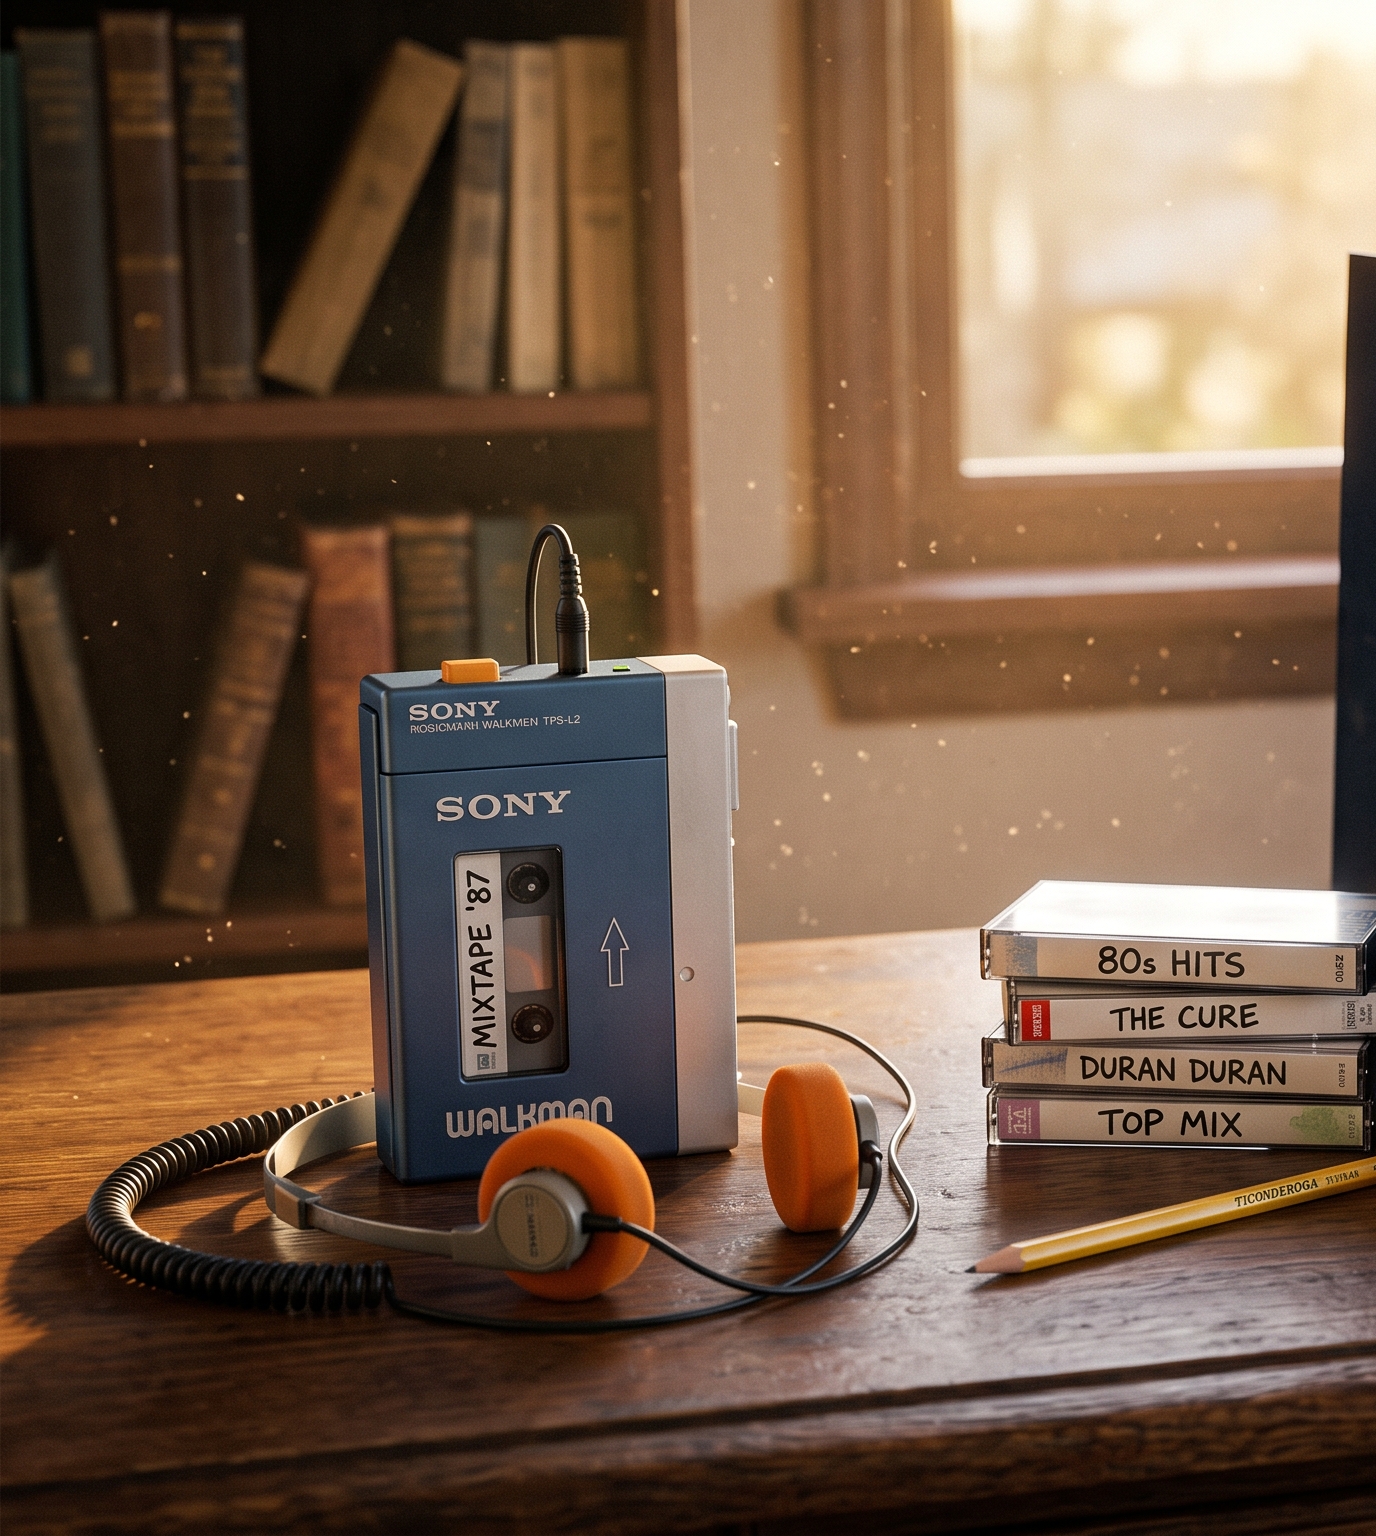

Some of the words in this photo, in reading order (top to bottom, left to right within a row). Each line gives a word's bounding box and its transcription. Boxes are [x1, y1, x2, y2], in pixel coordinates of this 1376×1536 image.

[409, 700, 500, 721] SONY
[482, 717, 538, 729] WALKMEN
[543, 714, 581, 726] TPS-L2
[436, 790, 571, 822] SONY
[465, 870, 492, 911] '87
[1098, 946, 1156, 974] 80s
[1171, 949, 1245, 978] HITS
[467, 924, 497, 1048] MIXTAPE
[1109, 1006, 1165, 1032] THE
[1178, 1003, 1259, 1029] CURE
[1080, 1055, 1175, 1082] DURAN
[1189, 1058, 1286, 1085] DURAN
[446, 1096, 613, 1138] WALKMAN
[1098, 1108, 1164, 1136] TOP
[1180, 1110, 1242, 1137] MIX
[1234, 1178, 1319, 1208] TICONDEROGA
